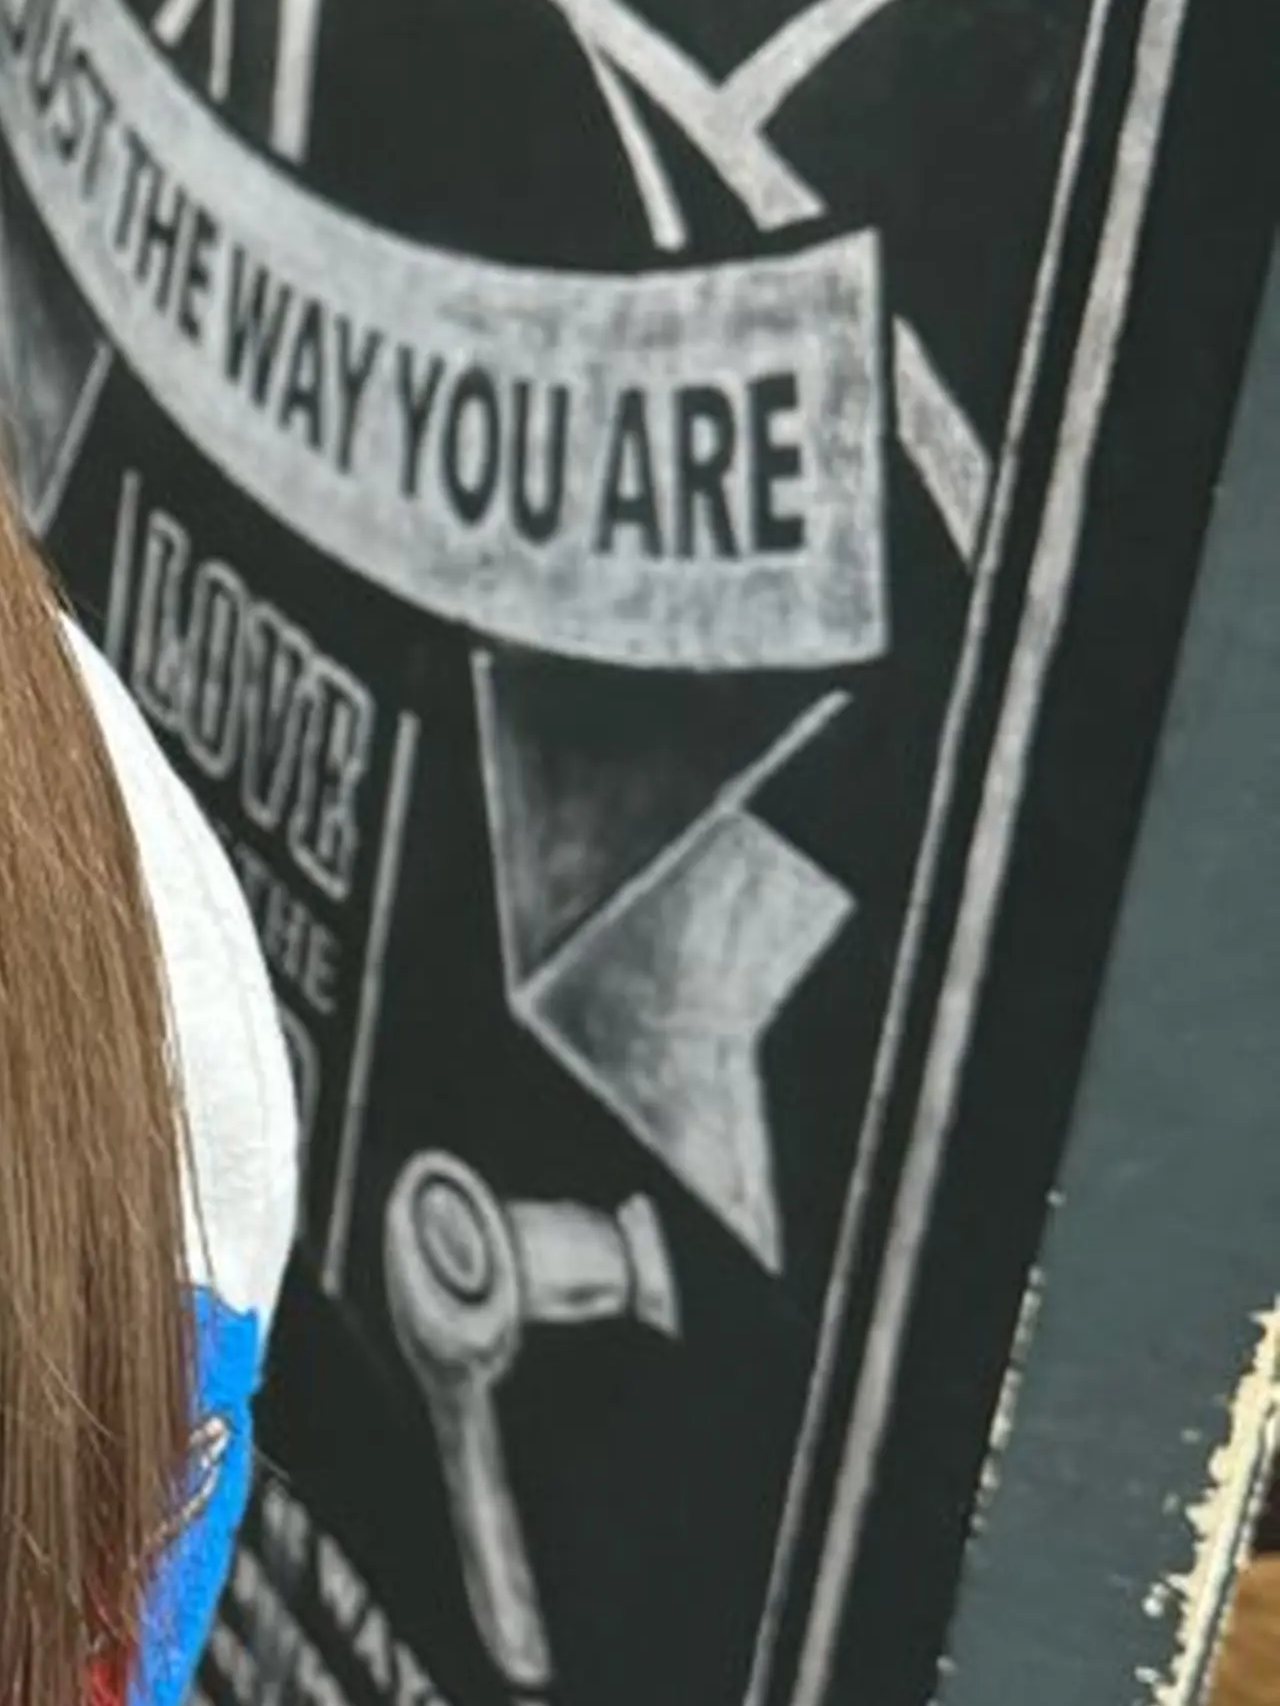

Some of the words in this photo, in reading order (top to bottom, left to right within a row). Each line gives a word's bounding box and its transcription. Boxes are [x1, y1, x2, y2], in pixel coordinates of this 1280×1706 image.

[114, 124, 220, 347] THE
[229, 244, 381, 473] WAY
[395, 348, 570, 544] YOU
[596, 374, 805, 563] ARE
